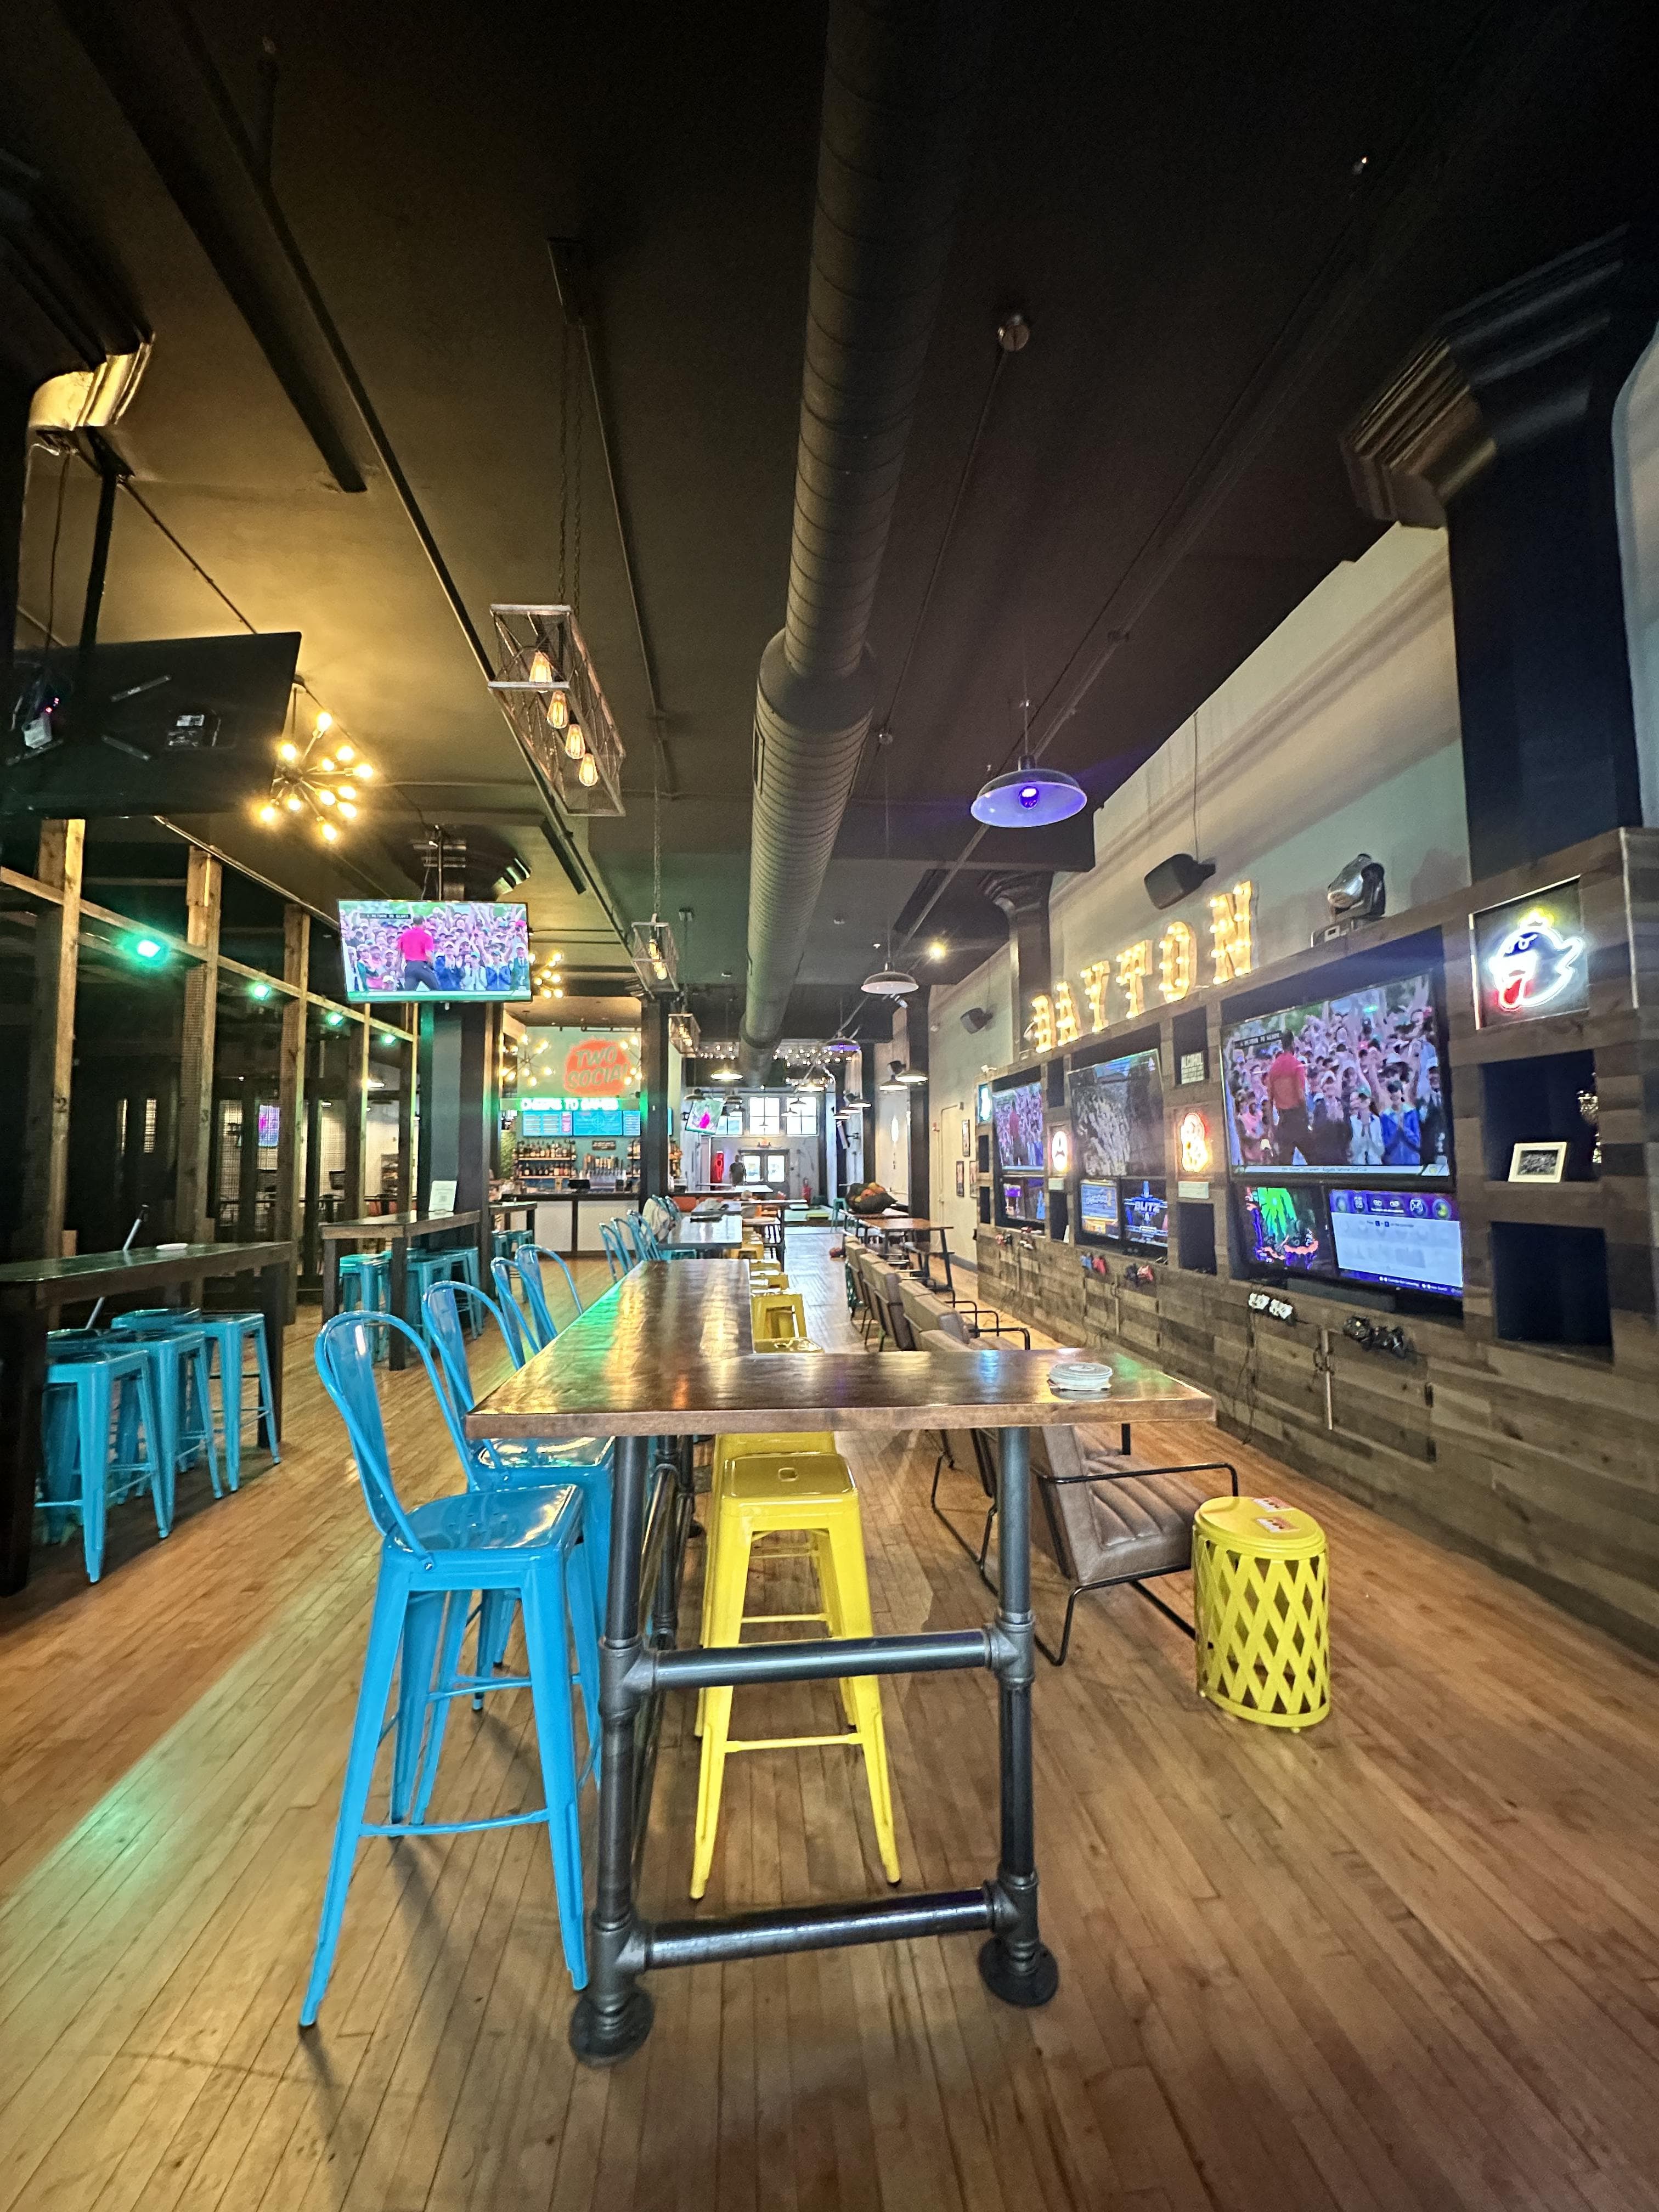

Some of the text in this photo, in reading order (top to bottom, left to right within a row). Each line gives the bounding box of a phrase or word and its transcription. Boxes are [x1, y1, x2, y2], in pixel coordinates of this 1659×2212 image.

[1031, 881, 1252, 1053] DAYTON
[576, 1046, 617, 1068] TWO
[565, 1098, 579, 1110] TO
[1133, 1200, 1160, 1214] BLITZ
